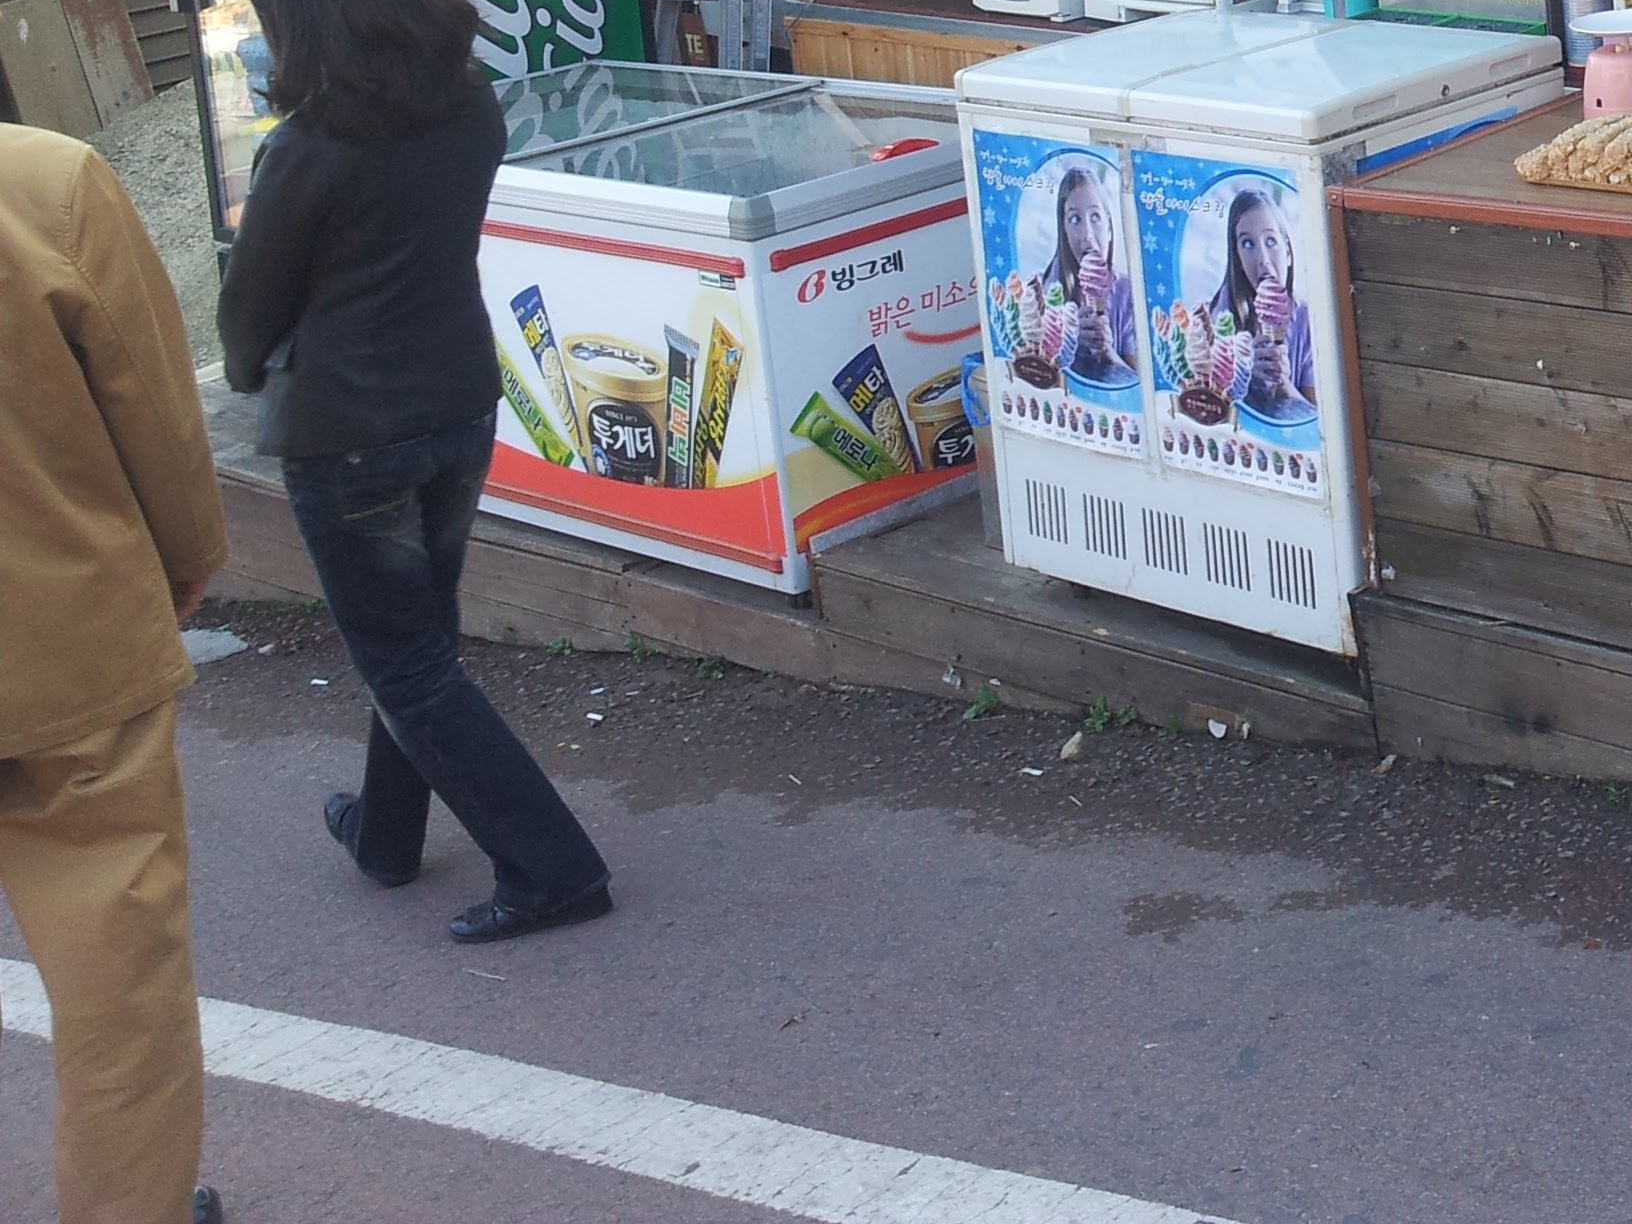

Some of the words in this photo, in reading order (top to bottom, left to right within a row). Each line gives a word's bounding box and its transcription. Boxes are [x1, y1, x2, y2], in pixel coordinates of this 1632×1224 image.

[831, 250, 904, 291] 빙그레
[868, 296, 915, 338] 밝은
[503, 367, 543, 432] 메로나
[668, 376, 692, 466] 비비빅
[592, 412, 656, 459] 투게더
[832, 427, 879, 472] 메로나
